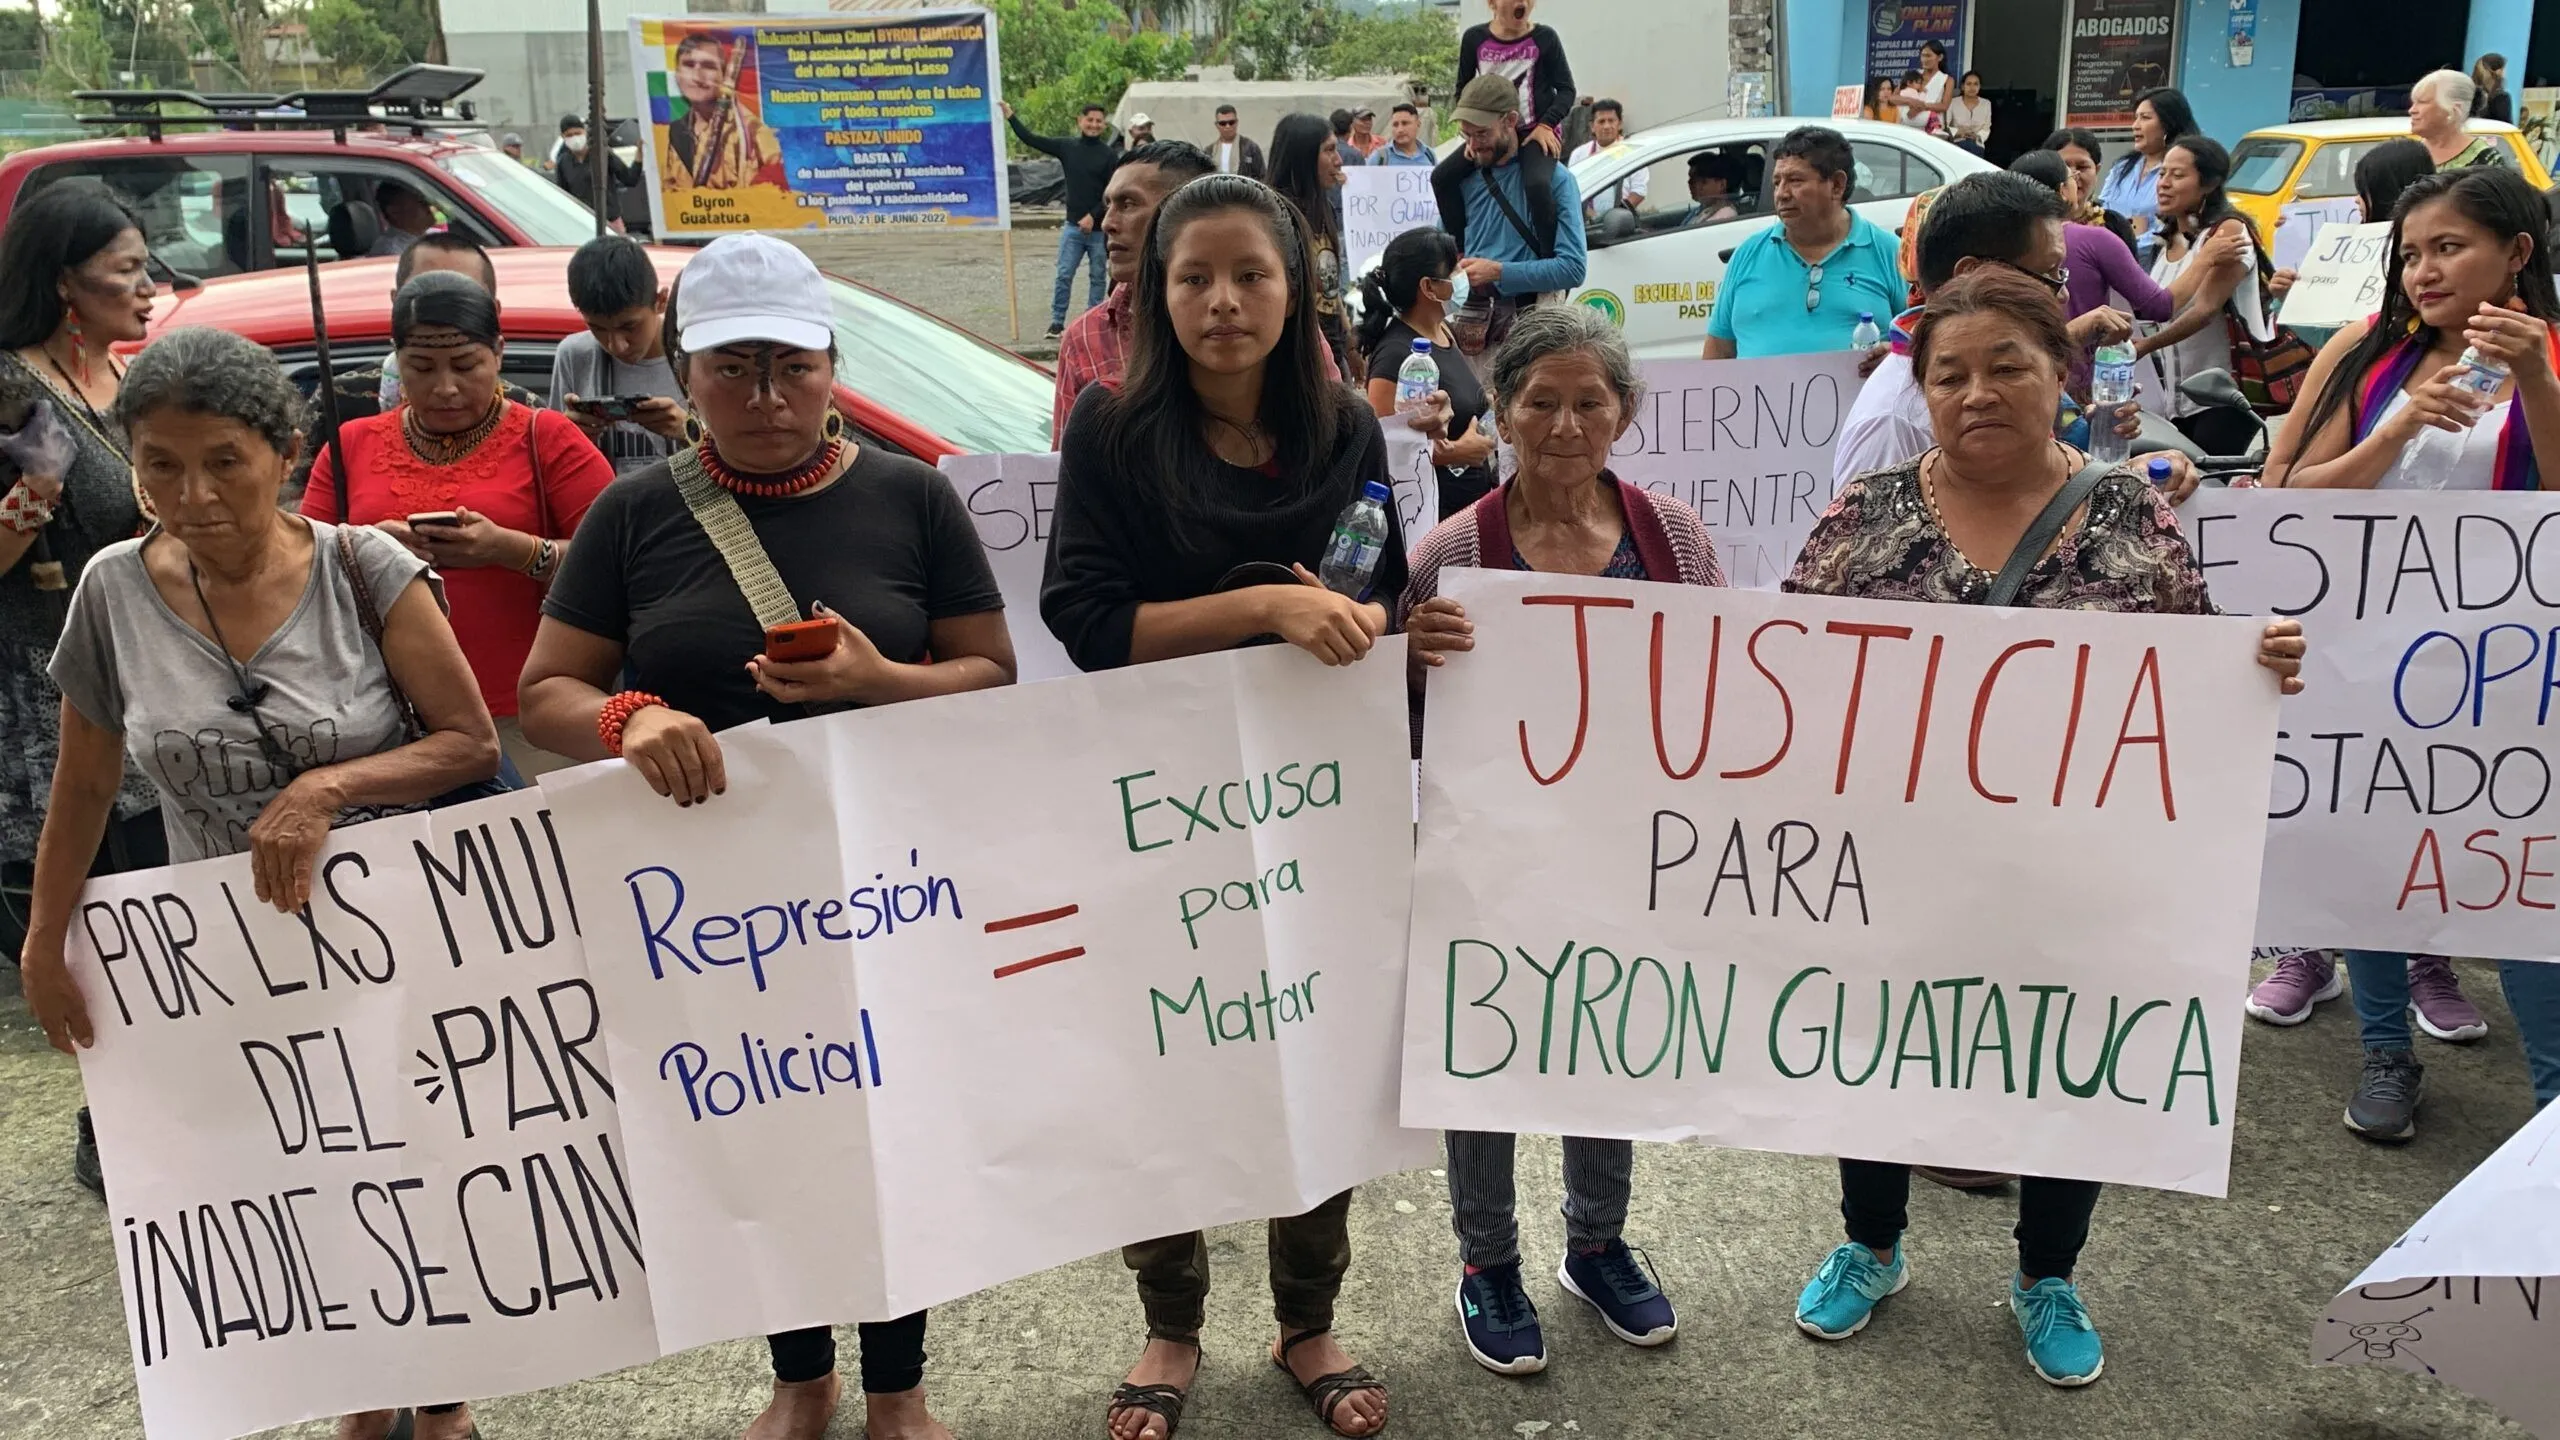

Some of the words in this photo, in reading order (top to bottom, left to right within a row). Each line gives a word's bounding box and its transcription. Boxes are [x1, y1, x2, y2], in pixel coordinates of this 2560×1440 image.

[876, 27, 917, 42] BYRON
[919, 25, 984, 41] GUATATUCA
[1912, 19, 1954, 32] PLAN
[2075, 16, 2169, 37] ABOGADOS
[788, 48, 807, 61] fue
[809, 47, 866, 61] asesinado
[869, 47, 888, 62] por
[890, 45, 901, 59] el
[903, 45, 953, 60] gobierno
[795, 64, 813, 78] del
[815, 64, 840, 78] odio
[842, 64, 857, 77] de
[859, 62, 913, 76] Guillermo
[915, 61, 948, 75] Lasso
[771, 89, 818, 102] Nuestro
[820, 88, 874, 101] hermano
[876, 86, 913, 100] murió
[916, 88, 931, 99] en
[933, 86, 946, 99] la
[948, 85, 981, 99] lucha
[2075, 83, 2092, 91] Civil
[821, 106, 842, 122] por
[844, 104, 878, 118] todos
[880, 104, 934, 118] nosotros
[825, 131, 880, 146] PASTAZA
[883, 130, 923, 145] UNIDO
[853, 152, 889, 165] BASTA
[891, 151, 906, 164] YA
[798, 168, 813, 179] de
[814, 166, 892, 179] humillaciones
[894, 169, 902, 179] y
[904, 164, 964, 177] asesinatos
[845, 180, 864, 192] del
[866, 179, 915, 193] gobierno
[693, 195, 734, 211] Byron
[798, 196, 807, 206] a
[808, 195, 825, 206] los
[828, 193, 872, 208] pueblos
[874, 195, 882, 206] y
[884, 191, 968, 205] nacionalidades
[1350, 196, 1379, 217] POR
[680, 212, 751, 225] Guatatuca
[859, 214, 870, 224] 21
[874, 213, 887, 224] DE
[890, 213, 919, 224] JUNIO
[921, 213, 946, 223] 2022
[2310, 275, 2340, 289] para
[1634, 282, 1692, 304] ESCUELA
[1695, 281, 1715, 300] DE
[1518, 595, 2178, 822] JUSTICIA
[1112, 760, 1342, 852] Excusa
[1648, 809, 1870, 926] PARA
[1179, 859, 1304, 950] para
[624, 847, 964, 992] Represión
[84, 895, 234, 1024] POR
[222, 851, 395, 996] LXS
[1150, 970, 1321, 1056] Matar
[1445, 938, 1737, 1080] BYRON
[1768, 966, 2221, 1126] GUATATUCA
[660, 1008, 882, 1121] Policial
[240, 1028, 406, 1155] DEL
[352, 1178, 470, 1326] SE
